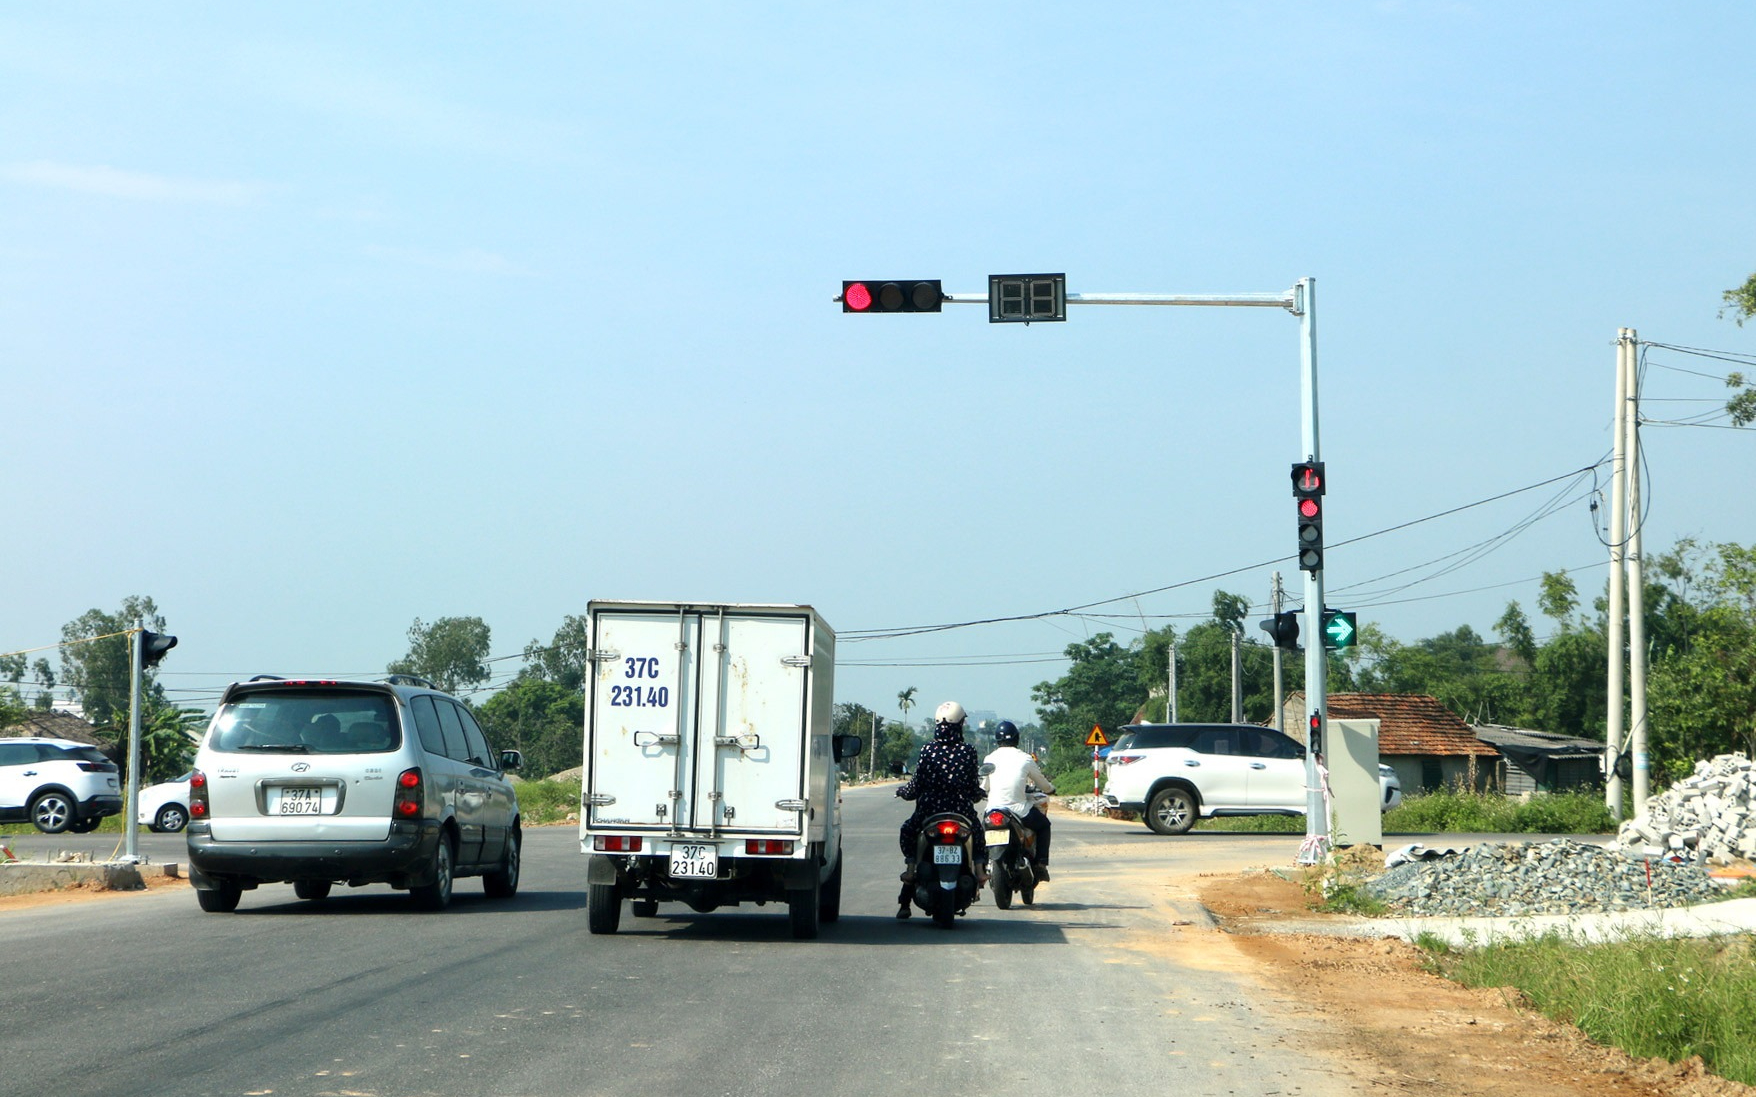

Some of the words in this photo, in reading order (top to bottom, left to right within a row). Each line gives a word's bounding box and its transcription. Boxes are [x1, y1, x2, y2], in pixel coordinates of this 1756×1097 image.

[625, 657, 659, 679] 37C
[611, 685, 669, 708] 231.40
[291, 789, 312, 801] 37A
[281, 802, 318, 814] 690.74
[682, 845, 706, 860] 37C
[672, 860, 715, 876] 231.40
